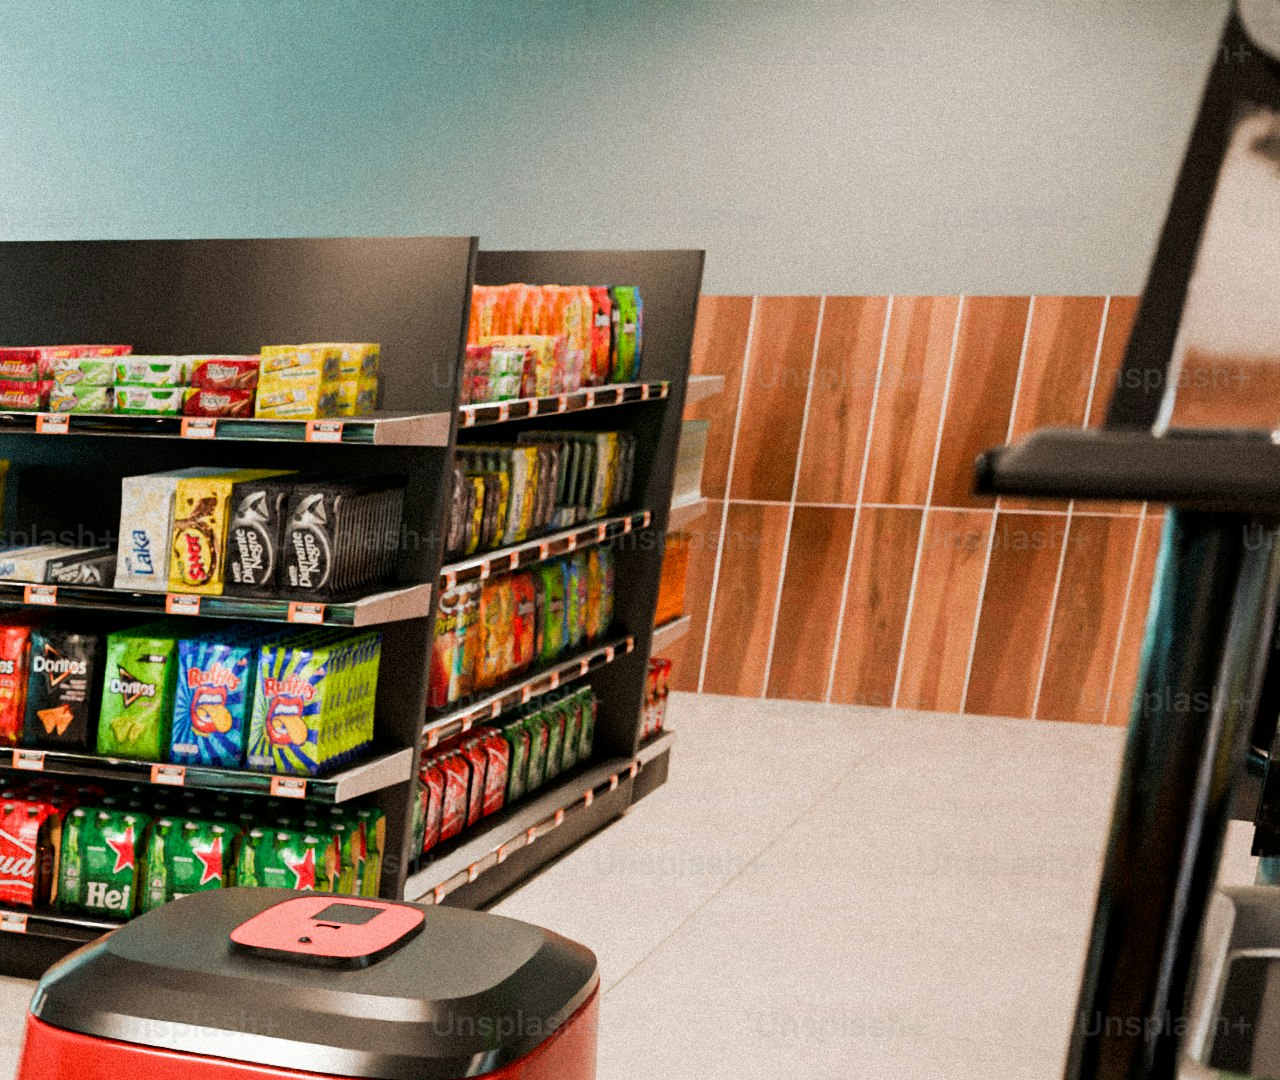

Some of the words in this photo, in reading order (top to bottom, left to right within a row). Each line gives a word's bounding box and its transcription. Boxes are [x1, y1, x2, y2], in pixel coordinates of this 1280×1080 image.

[132, 529, 154, 576] Laka
[235, 528, 256, 585] Diamante
[246, 530, 264, 571] Negro
[292, 531, 313, 589] Diamante
[303, 534, 321, 575] Negro
[32, 655, 88, 676] Doritos
[186, 663, 241, 691] Ruffles
[109, 678, 157, 698] Doritos
[263, 672, 319, 700] Ruffles
[84, 880, 132, 911] Hei
